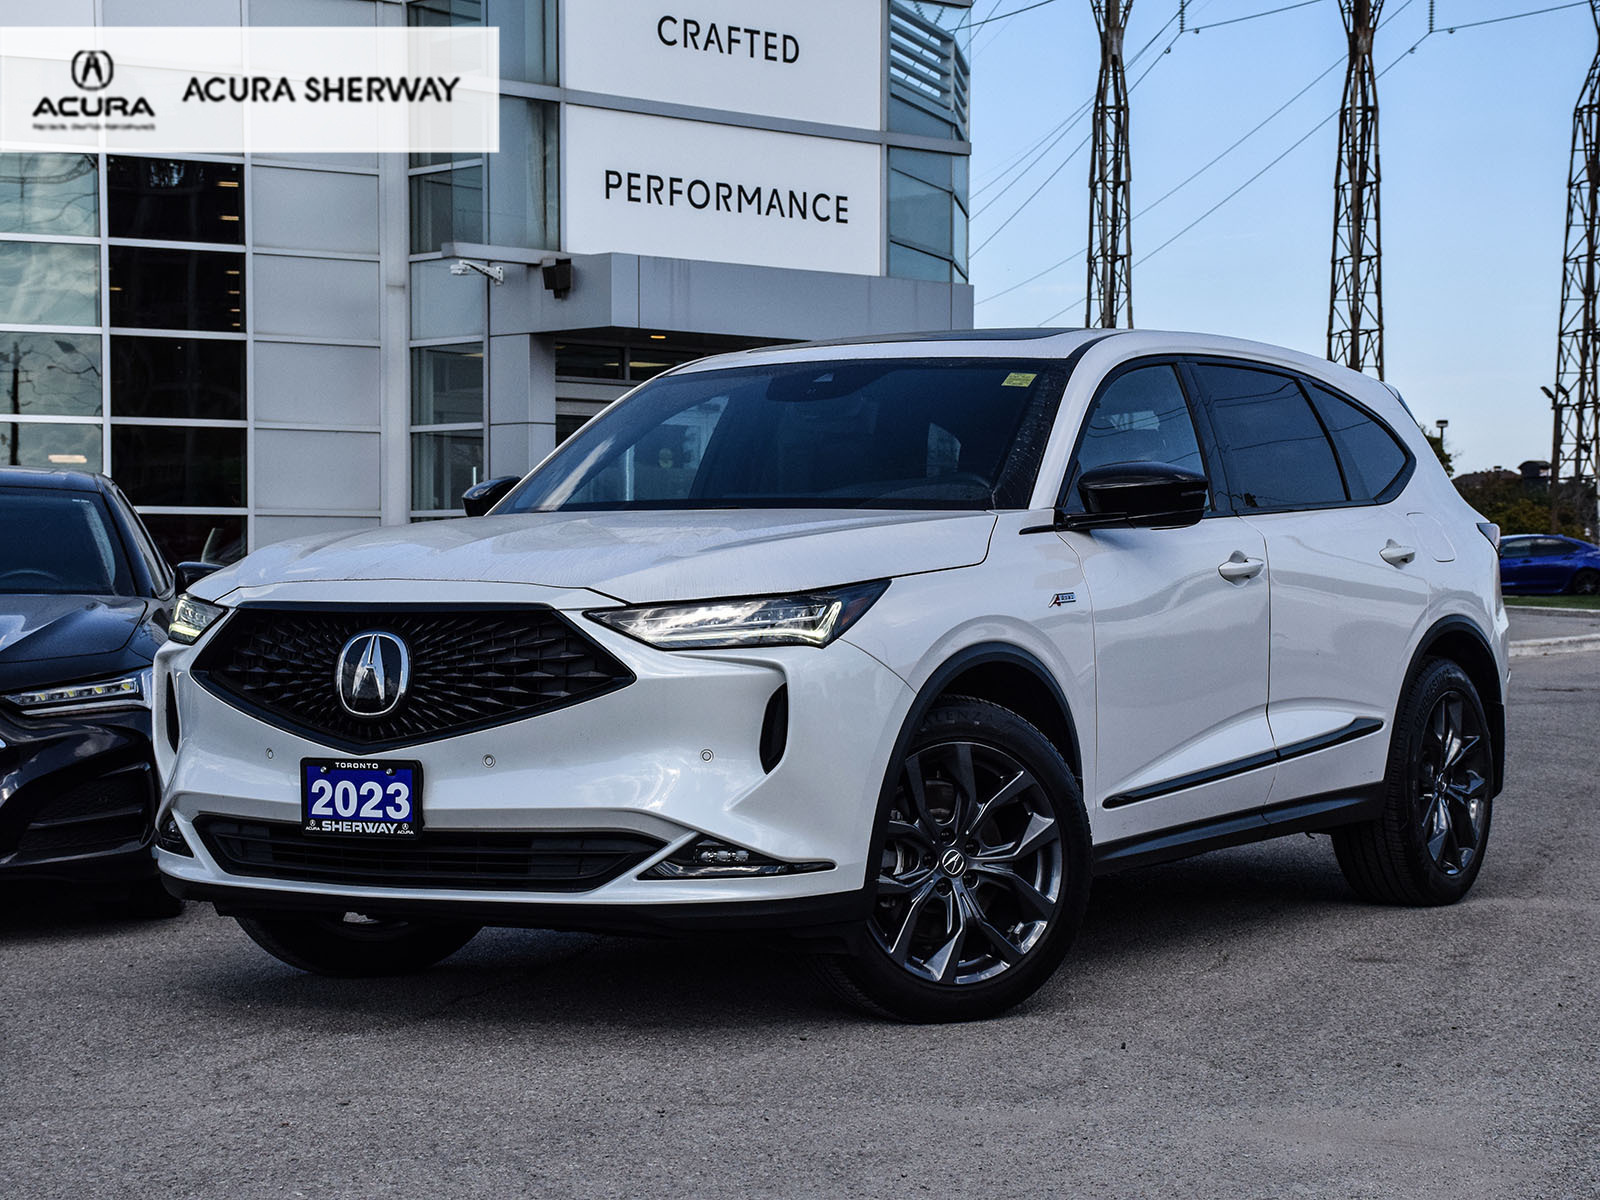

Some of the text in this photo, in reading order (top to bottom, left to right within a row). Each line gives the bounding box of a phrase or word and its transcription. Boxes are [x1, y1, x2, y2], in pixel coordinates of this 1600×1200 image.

[657, 15, 800, 64] CRAFTED
[605, 169, 849, 224] PERFORMANCE
[335, 761, 379, 769] TORONTO
[311, 779, 410, 820] 2023
[321, 820, 398, 834] SHERWAY
